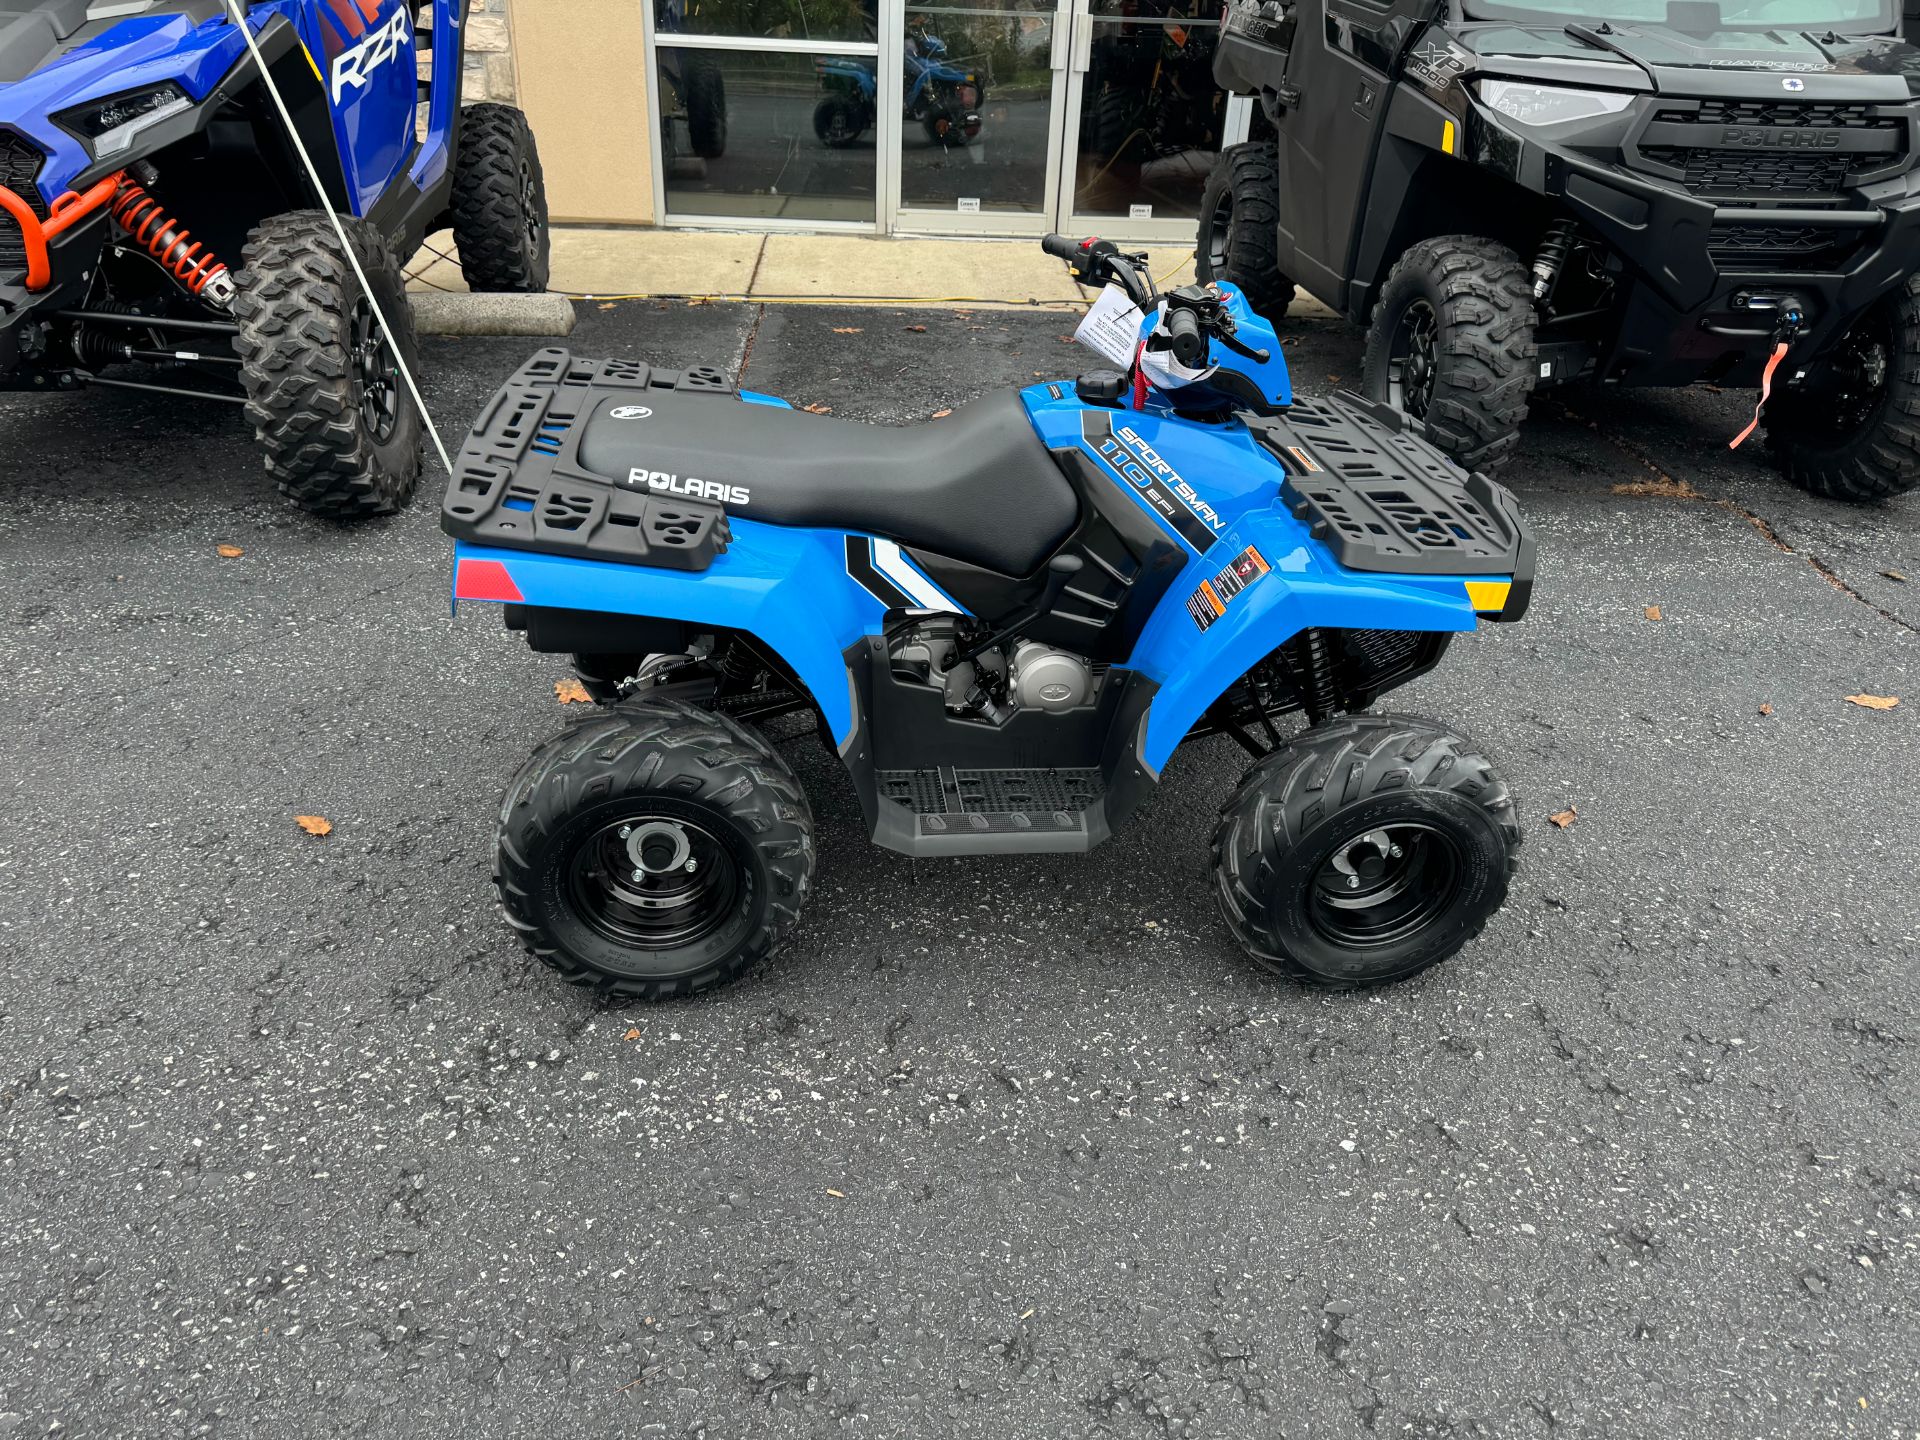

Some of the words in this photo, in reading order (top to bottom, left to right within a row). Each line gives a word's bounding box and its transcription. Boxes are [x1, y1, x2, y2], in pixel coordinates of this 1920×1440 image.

[1229, 13, 1268, 37] RANGER
[332, 5, 409, 107] RZR
[1411, 41, 1466, 73] XP
[1412, 62, 1450, 88] 1000
[1720, 128, 1840, 149] POLARIS
[628, 467, 750, 505] POLARIS
[1100, 438, 1153, 489] 110
[1146, 489, 1176, 515] EFI
[1117, 427, 1226, 530] SPORTSMAN
